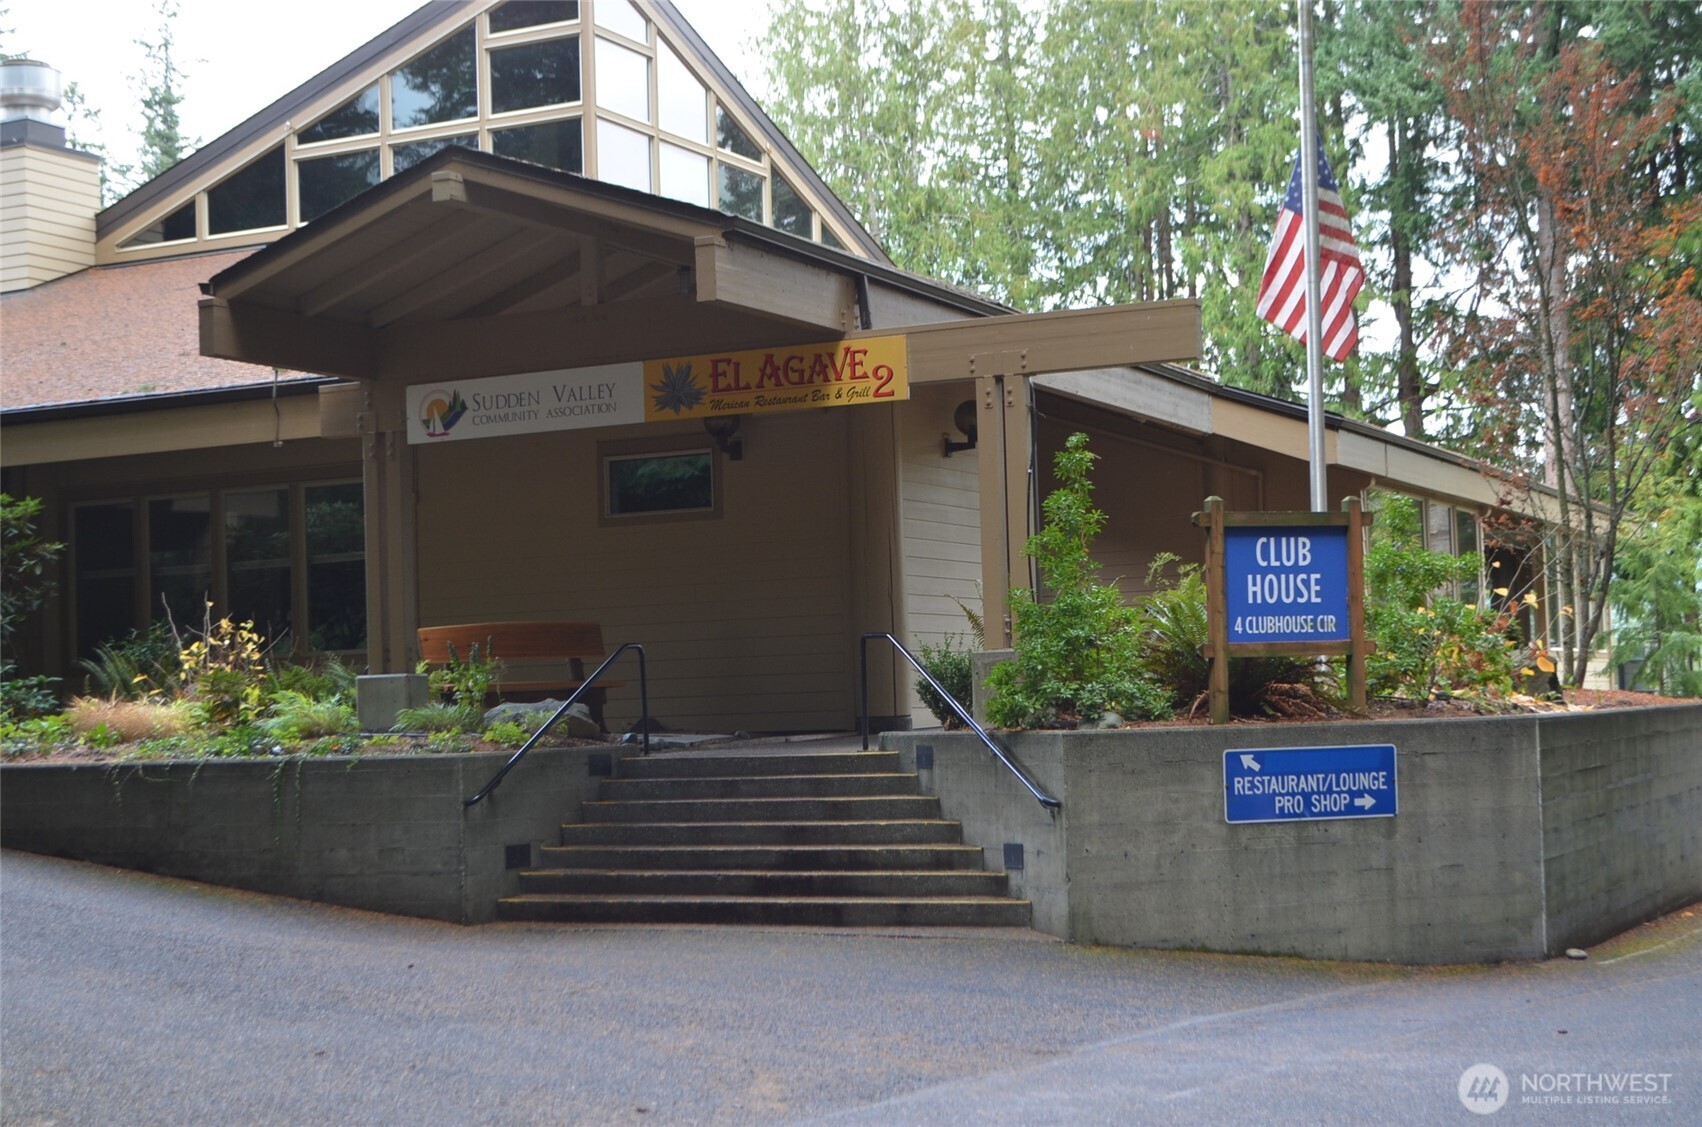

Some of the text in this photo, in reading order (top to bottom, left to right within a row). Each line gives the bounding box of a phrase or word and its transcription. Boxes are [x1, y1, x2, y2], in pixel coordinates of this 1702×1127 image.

[710, 346, 895, 398] EL AGAVE 2
[472, 383, 616, 412] SUDDEN VALLEY
[710, 385, 872, 411] Mexican Restaurant Bar & Grill
[472, 402, 617, 426] COMMUNITY ASSOCIATION
[1256, 537, 1311, 567] CLUB
[1247, 573, 1322, 604] HOUSE
[1234, 614, 1336, 634] 4 CLUBHOUSE CIR
[1234, 771, 1388, 796] RESTAURANT/LOUNGE
[1275, 794, 1350, 814] PRO SHOP
